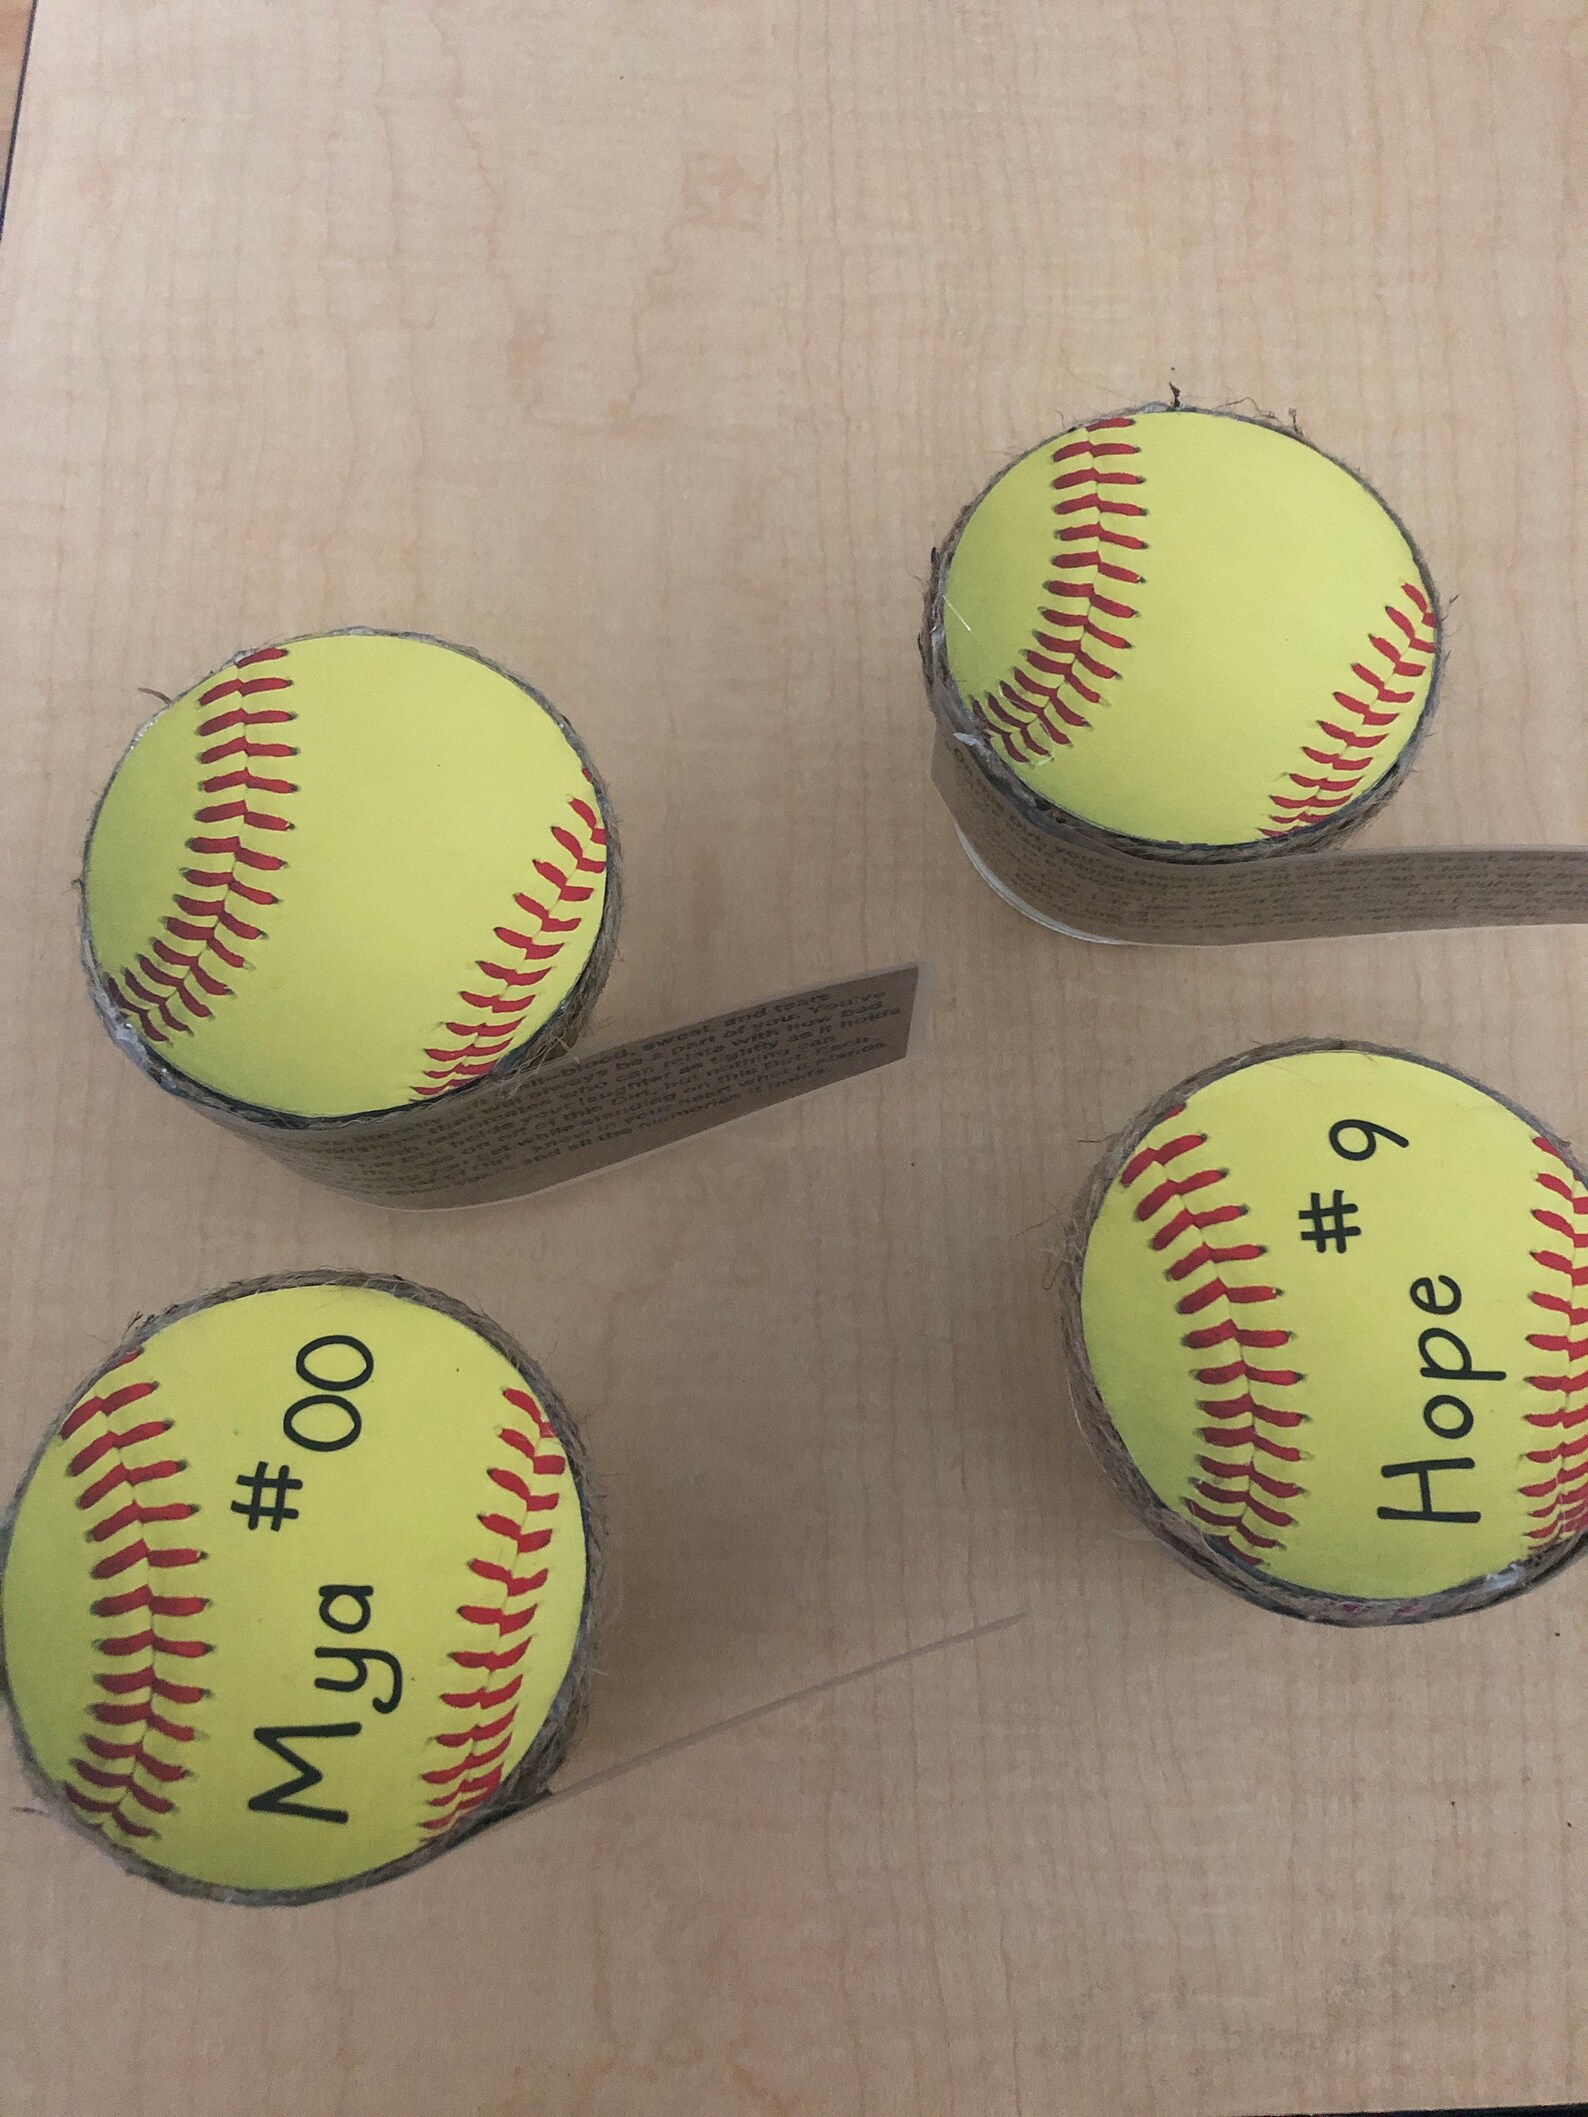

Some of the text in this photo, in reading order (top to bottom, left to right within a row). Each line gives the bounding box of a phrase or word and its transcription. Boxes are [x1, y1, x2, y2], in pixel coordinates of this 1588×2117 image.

[1298, 1118, 1410, 1254] #9
[230, 1334, 375, 1533] #00
[1376, 1274, 1507, 1524] Hope
[246, 1584, 403, 1826] Mya
